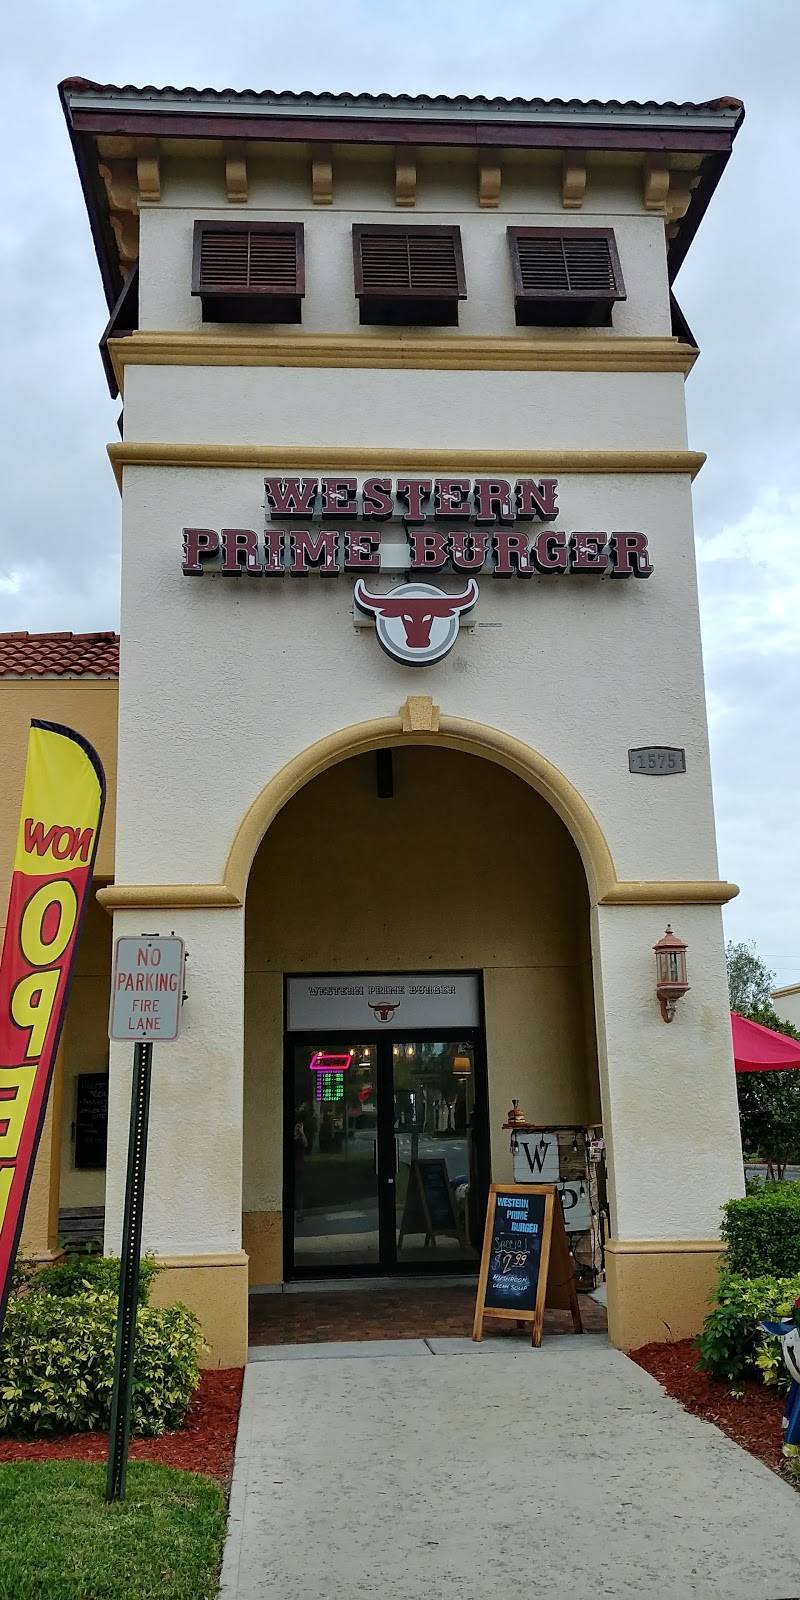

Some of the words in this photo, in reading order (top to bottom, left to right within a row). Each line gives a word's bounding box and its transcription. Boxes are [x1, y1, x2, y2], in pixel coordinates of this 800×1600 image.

[264, 477, 560, 523] WESTERN
[182, 528, 382, 576] PRIME
[409, 531, 654, 578] BURGER
[637, 752, 676, 769] 1575
[137, 948, 162, 967] NO
[116, 973, 178, 992] PARKING
[308, 985, 364, 996] WESTERN
[368, 984, 406, 995] PRIME
[409, 983, 457, 995] BURGER
[132, 999, 160, 1012] FIRE
[128, 1017, 161, 1030] LANE
[520, 1142, 552, 1174] W
[497, 1197, 529, 1209] WESTERN
[558, 1188, 578, 1225] P
[506, 1209, 529, 1221] PRIME
[511, 1221, 539, 1234] BURGER
